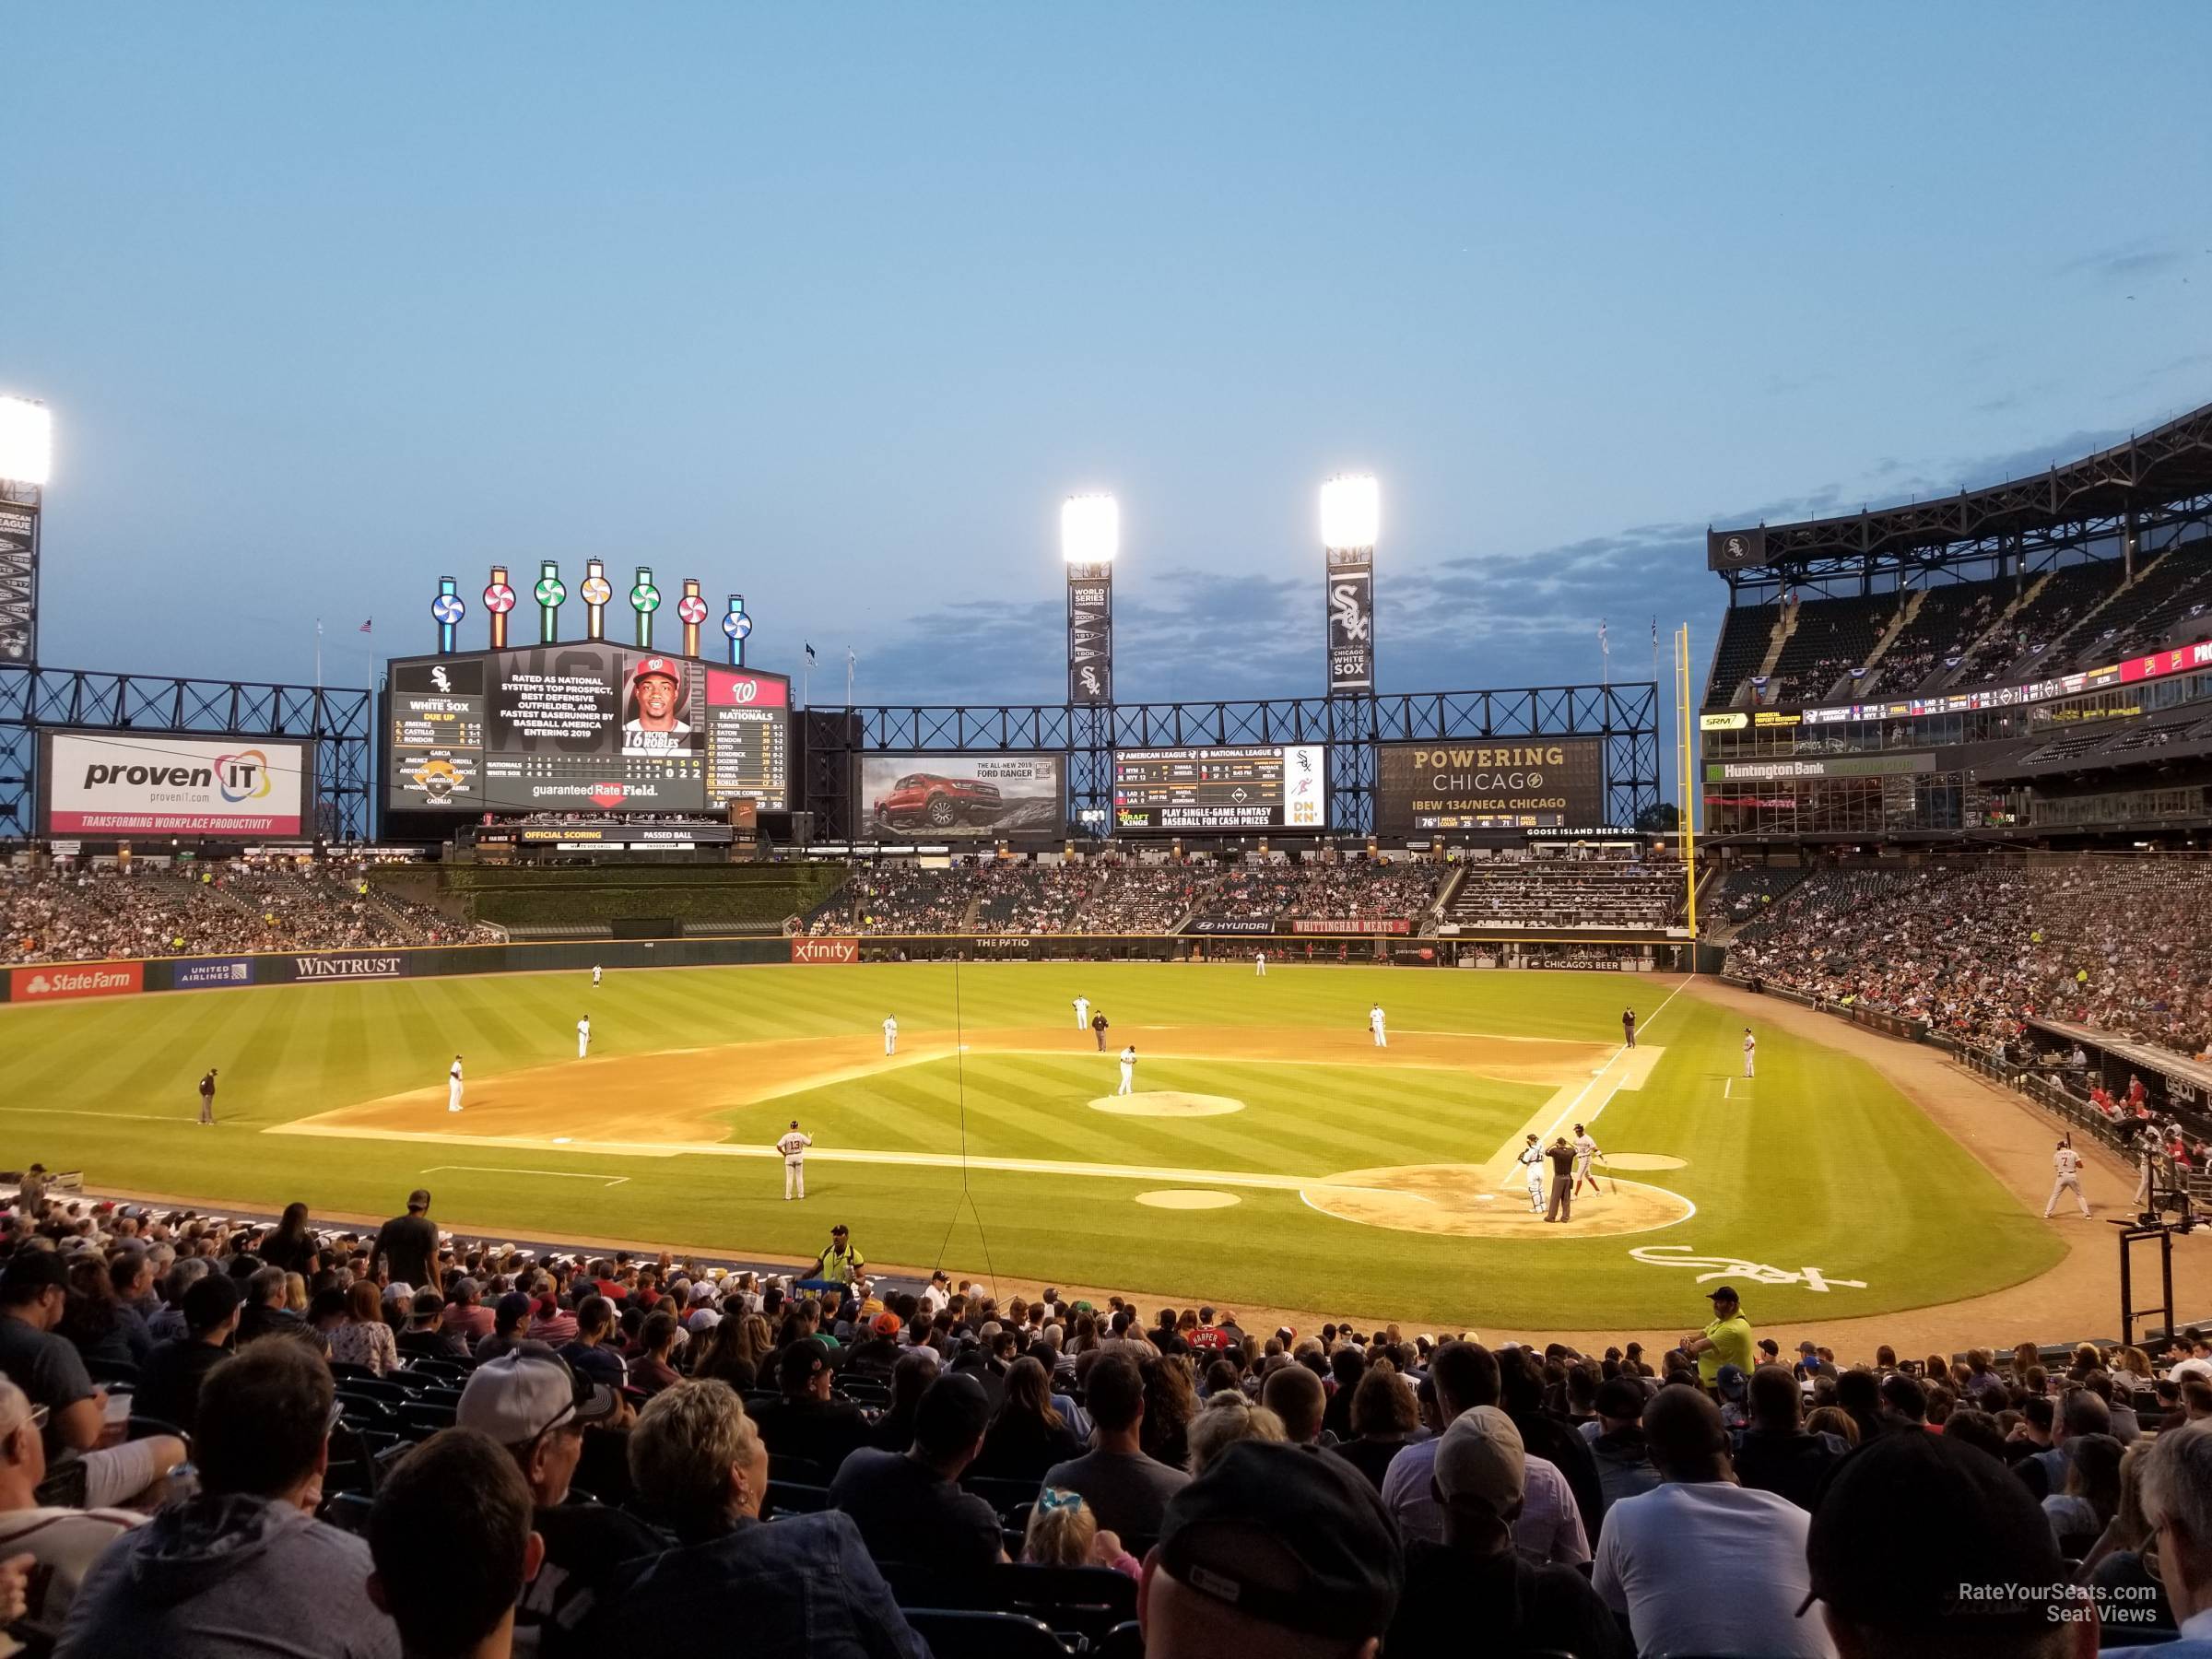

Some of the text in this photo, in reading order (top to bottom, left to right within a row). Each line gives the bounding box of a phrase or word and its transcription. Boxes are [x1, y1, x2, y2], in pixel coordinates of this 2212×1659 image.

[1335, 655, 1364, 664] WHITE
[1335, 664, 1364, 675] SOX
[512, 675, 542, 683] RATED
[559, 677, 603, 685] NATIONAL
[566, 686, 613, 695] PROSPECT,
[546, 694, 594, 702] DEFENSIVE
[410, 701, 469, 712] WHITE SOX
[518, 701, 597, 712] OUTFIELDER, AND
[541, 712, 600, 720] BASERUNNER
[719, 712, 773, 721] NATIONALS
[513, 720, 602, 729] BASEBALL AMERICA
[524, 728, 591, 737] ENTERING 2019
[625, 732, 642, 747] 16
[643, 738, 679, 748] ROBLES
[1125, 751, 1160, 759] AMERICAN
[1415, 747, 1564, 769] POWERING
[666, 769, 674, 778] 0
[679, 769, 688, 778] 2
[692, 769, 700, 778] 2
[977, 769, 1032, 778] FORD RANGER
[1724, 763, 1794, 779] Huntington
[1794, 761, 1824, 775] Bank
[84, 764, 256, 789] proven IT
[1433, 772, 1544, 791] CHICAGO
[533, 785, 658, 797] guaranteed Rate Field.
[150, 791, 209, 803] provenIT.com
[1293, 802, 1313, 811] DN
[1412, 798, 1566, 811] IBEW 134/NECA CHICAGO
[1120, 813, 1149, 821] DRAFT
[1162, 807, 1271, 817] PLAY SINGLE-GAME FANTASY
[82, 815, 272, 830] TRANSFORMING WORKPLACE PRODUCTIVITY
[1162, 816, 1269, 826] BASEBALL FOR CASH PRIZES
[1217, 922, 1268, 932] HYUNDAI
[1296, 921, 1359, 933] WHITTINGHAM
[1363, 921, 1394, 933] MEATS
[976, 938, 1030, 947] THE PATIO
[795, 941, 854, 962] xfinity
[191, 966, 229, 974] UNITED
[296, 958, 401, 976] WINTRUST
[1544, 960, 1618, 970] CHICAGO'S BEER
[182, 971, 229, 982] AIRLINES
[2166, 1077, 2194, 1102] GEICO
[790, 1141, 800, 1150] 13
[2062, 1158, 2067, 1166] 7
[1194, 1333, 1218, 1344] HARPER
